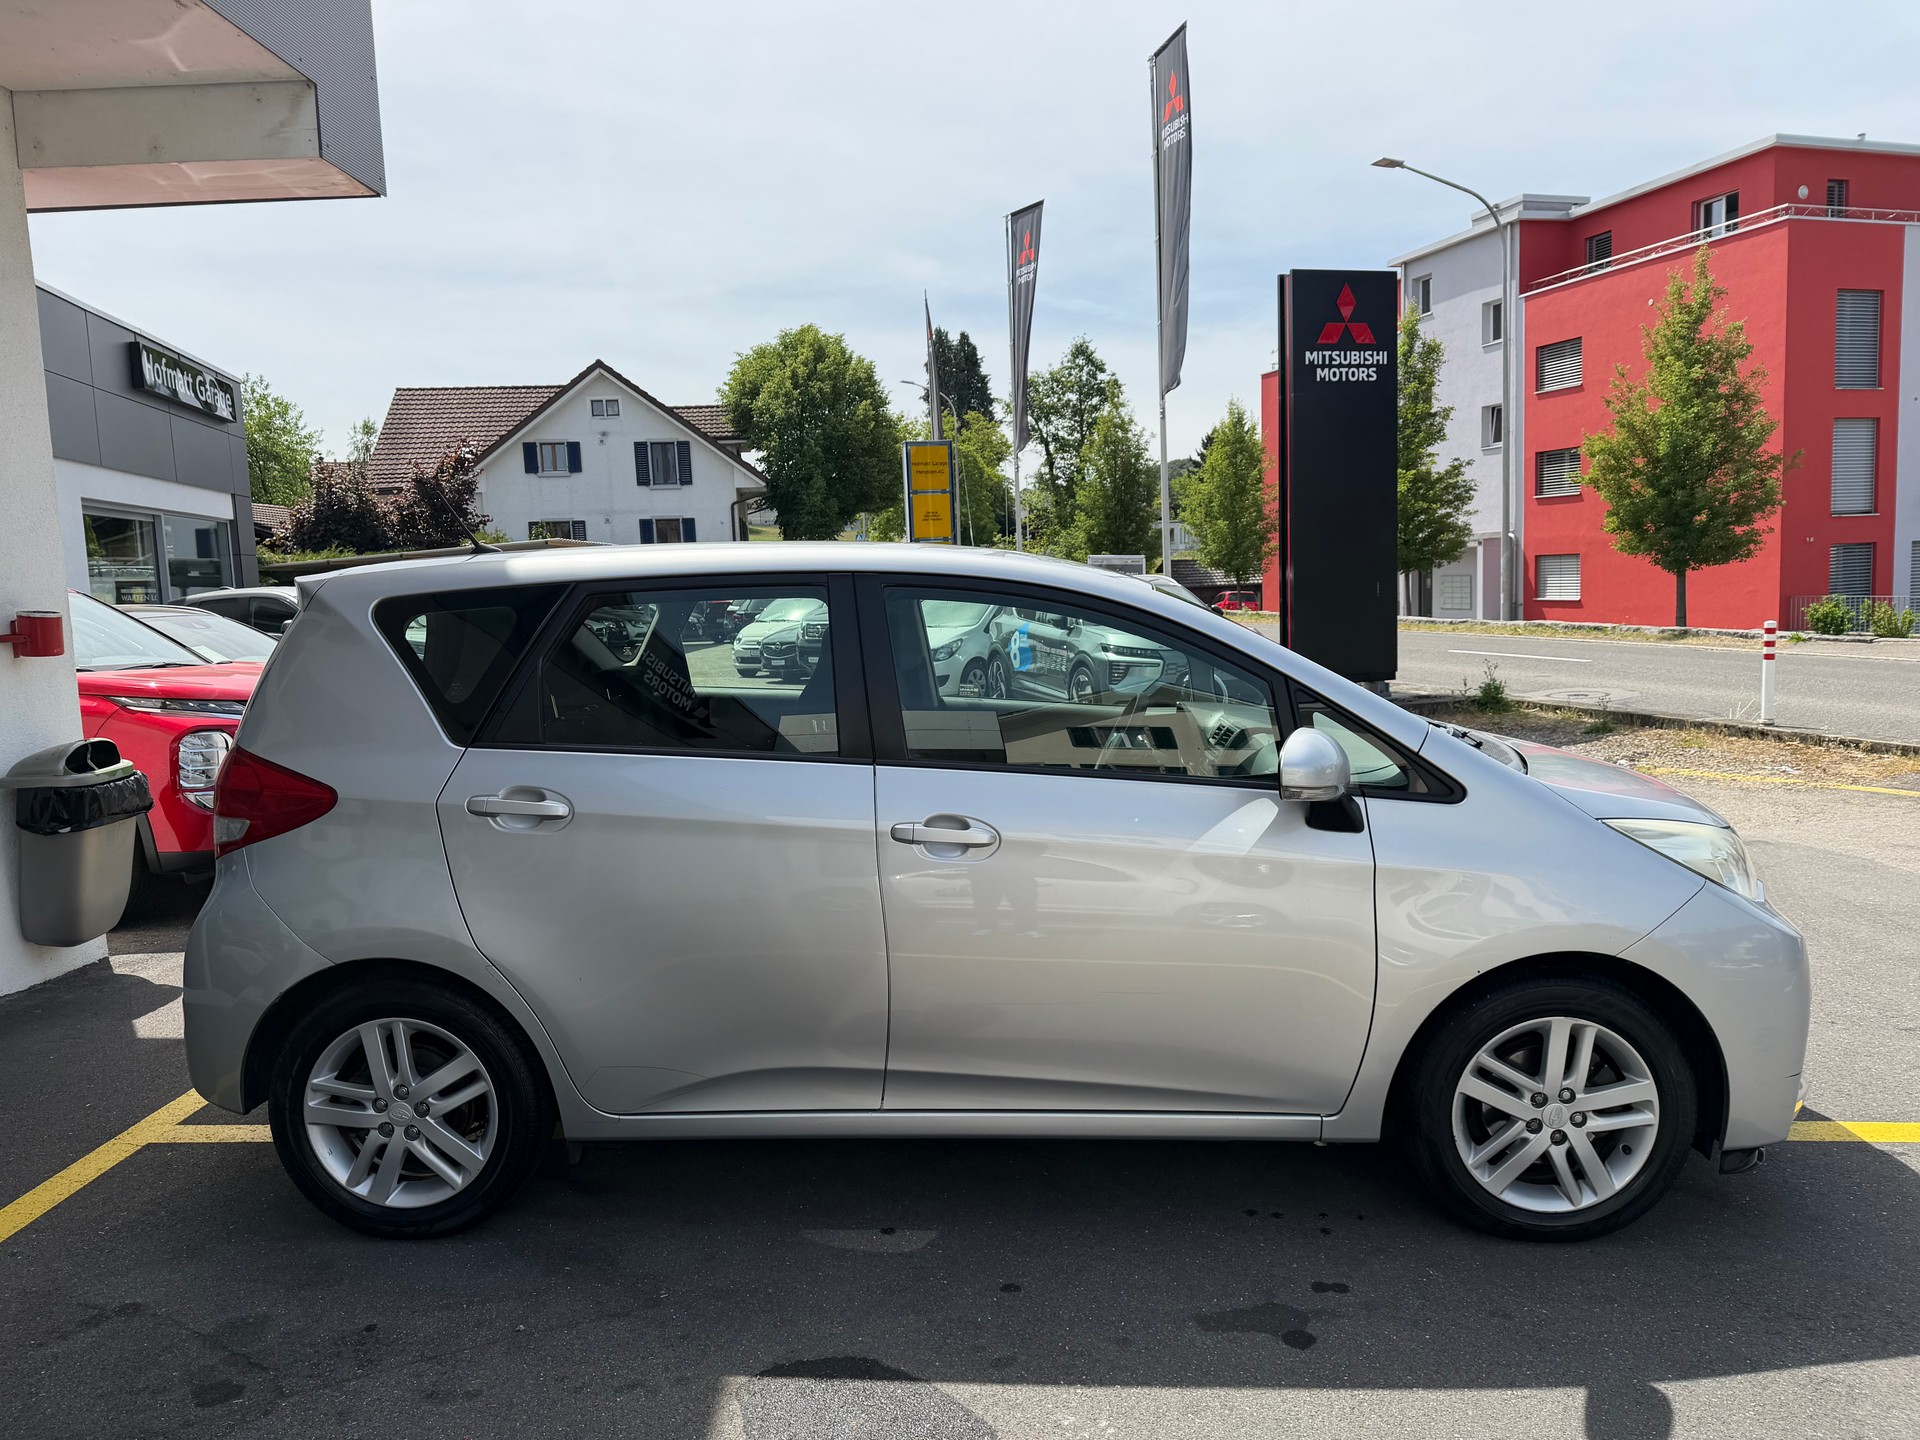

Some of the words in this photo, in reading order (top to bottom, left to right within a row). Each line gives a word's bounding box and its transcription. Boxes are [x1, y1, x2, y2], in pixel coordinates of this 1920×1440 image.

[1162, 112, 1189, 141] ITSUBISH
[1305, 351, 1388, 365] MITSUBISHI
[141, 349, 194, 397] Hofmatt
[196, 375, 233, 415] Garage
[1316, 367, 1377, 382] MOTORS
